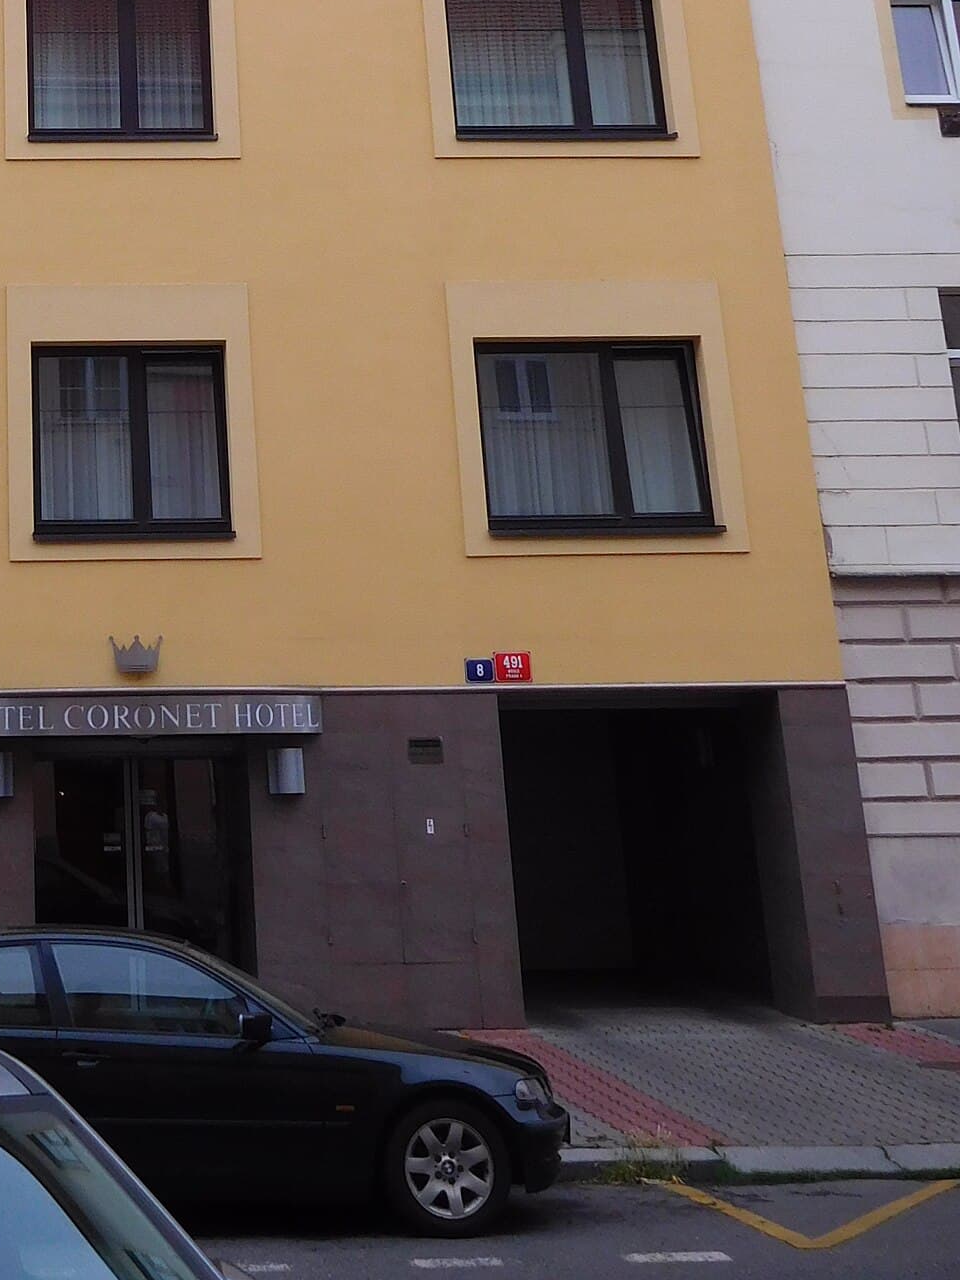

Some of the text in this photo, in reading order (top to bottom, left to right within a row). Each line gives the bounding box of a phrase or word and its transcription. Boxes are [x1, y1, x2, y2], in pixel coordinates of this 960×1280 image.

[503, 655, 523, 669] 491
[476, 663, 484, 677] 8
[64, 703, 223, 730] CORONET
[235, 702, 320, 728] HOTEL
